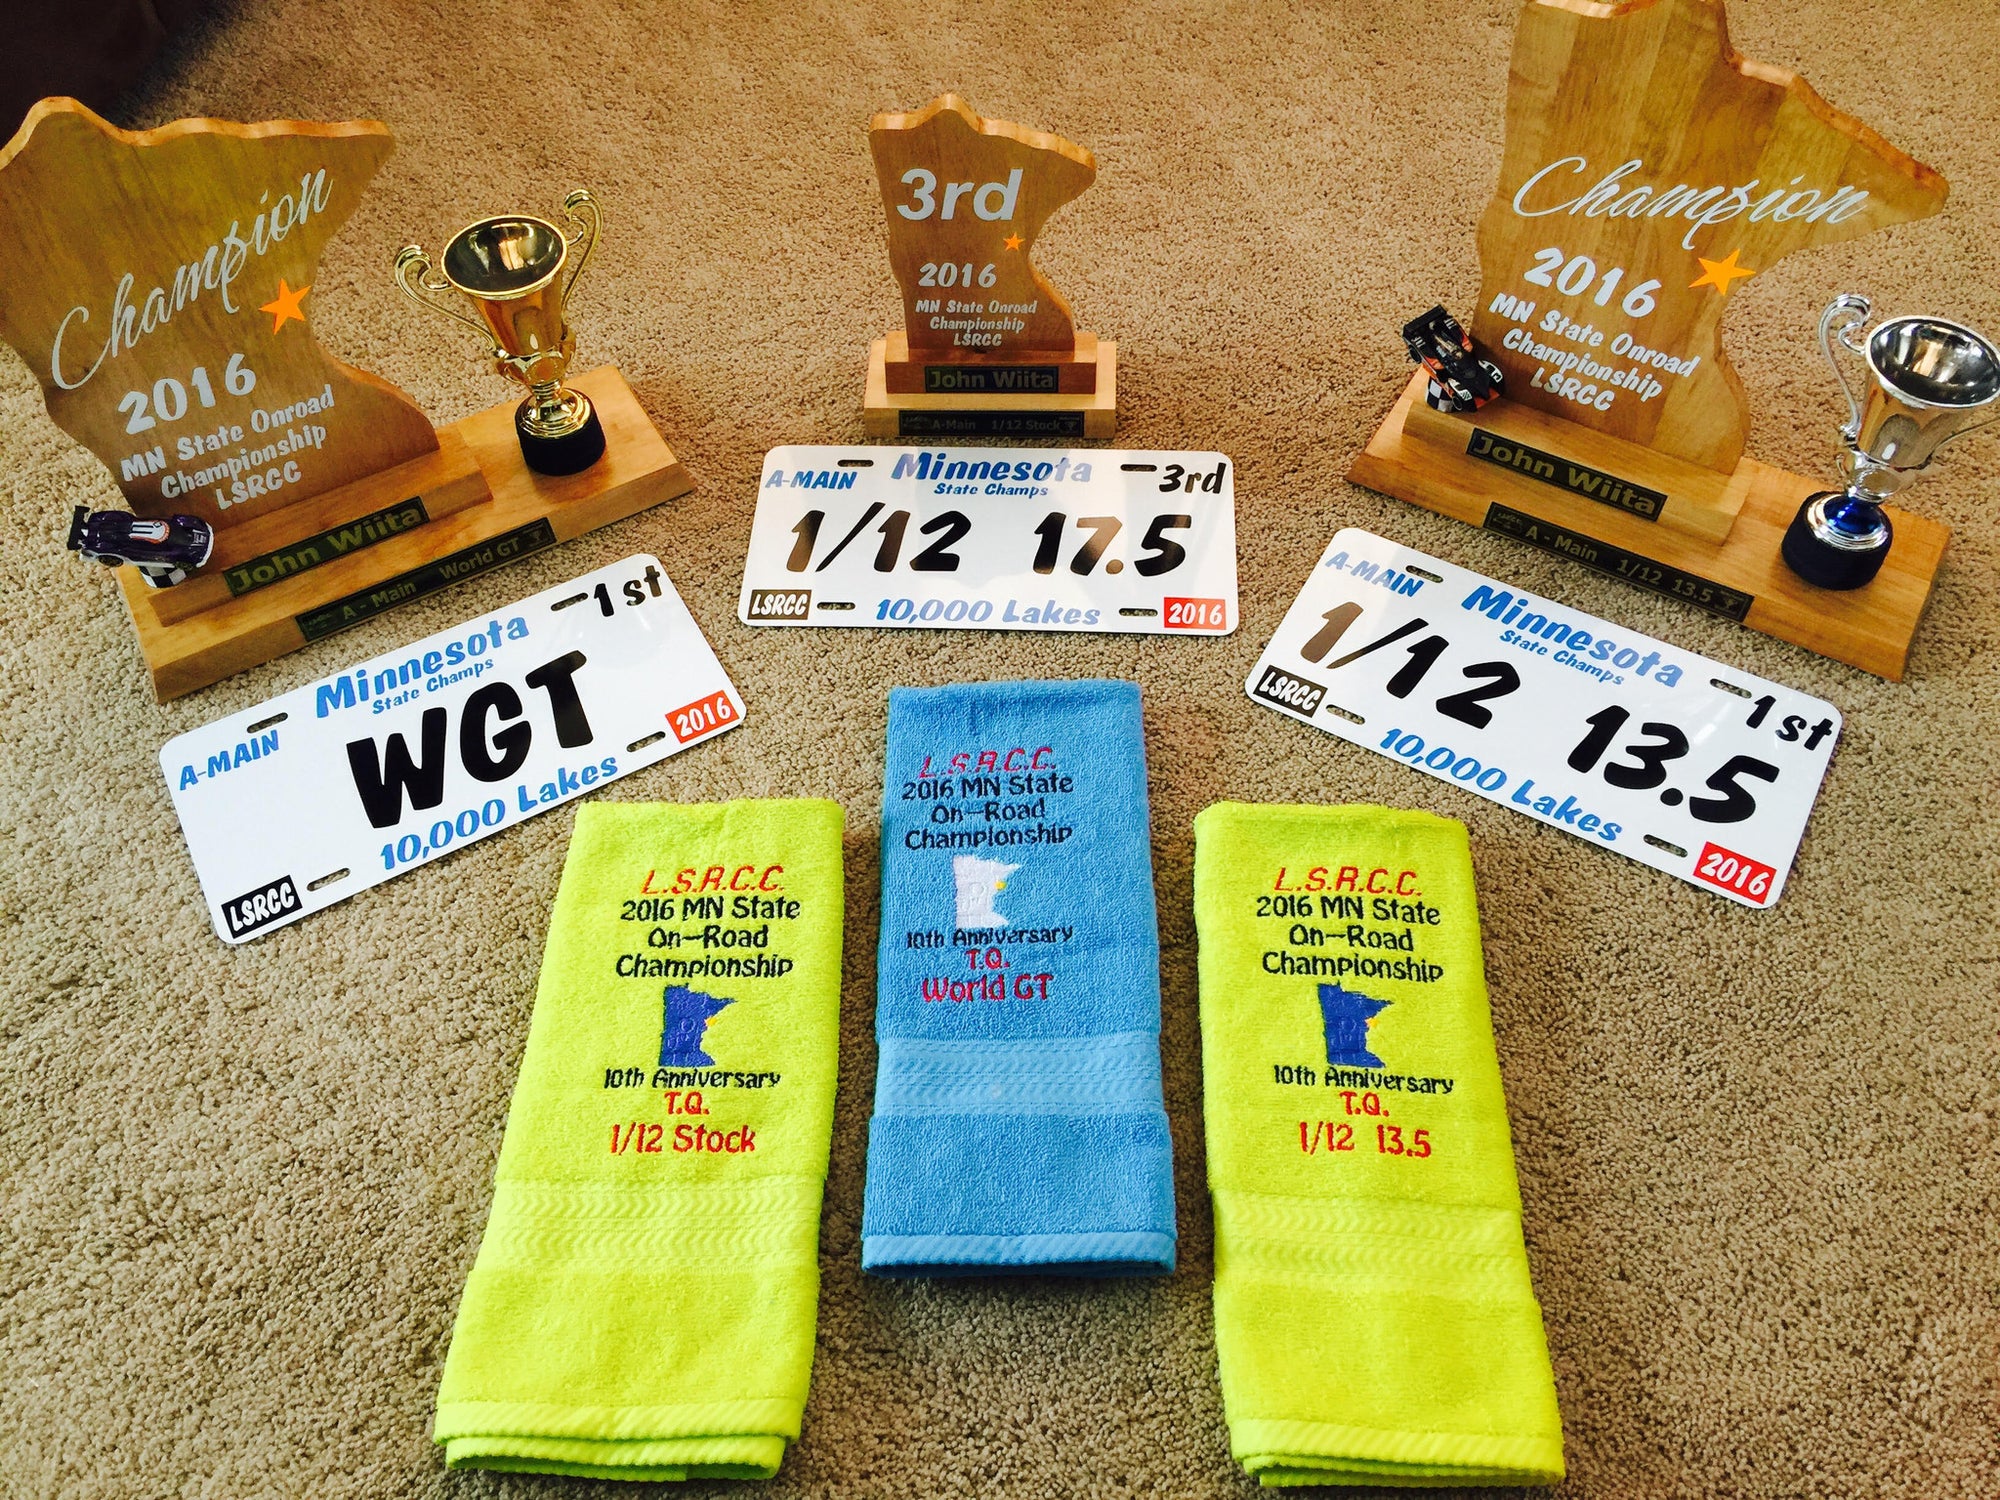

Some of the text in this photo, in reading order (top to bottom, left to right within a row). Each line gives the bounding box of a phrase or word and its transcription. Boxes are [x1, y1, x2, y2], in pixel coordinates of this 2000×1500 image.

[896, 168, 1023, 221] 3rd
[1512, 156, 1871, 250] Champion
[51, 168, 334, 390] Champion
[918, 262, 997, 289] 2016
[1523, 246, 1662, 318] 2016
[915, 300, 1038, 315] MN State Onroad
[929, 316, 1025, 334] Championship
[954, 332, 1002, 347] LSRCC
[1488, 291, 1701, 379] MN State Onroad
[929, 370, 1055, 390] John Wiita
[1502, 327, 1663, 403] Championship
[117, 353, 257, 435] 2016
[1529, 367, 1616, 412] LSRCC
[120, 384, 335, 482] MN State Onroad
[991, 419, 1023, 431] 1/12
[1025, 418, 1061, 431] Stock
[161, 424, 326, 499] Championship
[765, 469, 858, 490] A-MAIN
[890, 451, 1092, 483] Minnesota
[1158, 462, 1227, 494] 3rd
[1473, 435, 1656, 515] John Wiita
[215, 460, 301, 510] LSRCC
[933, 482, 1048, 499] State Champs
[232, 506, 421, 593] John Wiita
[786, 501, 1192, 577] 1/12 17.5
[372, 580, 417, 608] Main
[439, 549, 494, 580] World
[497, 537, 520, 560] GT
[1325, 550, 1425, 598] A-MAIN
[1554, 533, 1599, 562] Main
[1617, 559, 1664, 585] 1/12
[1671, 577, 1714, 604] 13.5
[594, 565, 662, 617] 1st
[751, 593, 808, 617] LSRCC
[875, 598, 1101, 626] 10,000 Lakes
[1167, 602, 1223, 626] 2016
[1460, 584, 1684, 689] Minnesota
[316, 617, 530, 718] Minnesota
[1499, 629, 1625, 686] State Champs
[372, 658, 494, 715] State Champs
[1259, 670, 1321, 711] LSRCC
[676, 697, 731, 737] 2016
[1300, 601, 1780, 824] 1/12 13.5
[1745, 694, 1834, 752] 1st
[346, 650, 594, 829] WGT
[179, 730, 279, 791] A-MAIN
[902, 772, 1074, 801] 2016 MN State
[1379, 728, 1624, 843] 10,000 Lakes
[380, 754, 618, 870] 10,000 Lakes
[905, 823, 1073, 851] Championship
[641, 864, 785, 895] L.S.R.C.C.
[1273, 865, 1423, 897] L.S.R.C.C.
[1700, 850, 1771, 897] 2016
[229, 884, 295, 932] LSRCC
[620, 895, 800, 922] 2016 MN State
[1256, 894, 1441, 926] 2016 MN State
[907, 925, 1073, 949] 10th Anniversary
[615, 953, 794, 978] Championship
[965, 947, 1010, 970] T.Q.
[1262, 951, 1444, 983] Championship
[921, 973, 1054, 1003] World GT
[604, 1067, 781, 1089] 10th Anniversary
[1274, 1064, 1454, 1095] 10th Anniversary
[664, 1090, 710, 1115] T.Q.
[1339, 1090, 1390, 1117] T.Q.
[610, 1122, 756, 1155] 1/12 Stock
[1299, 1121, 1432, 1158] 1/12 13.5
